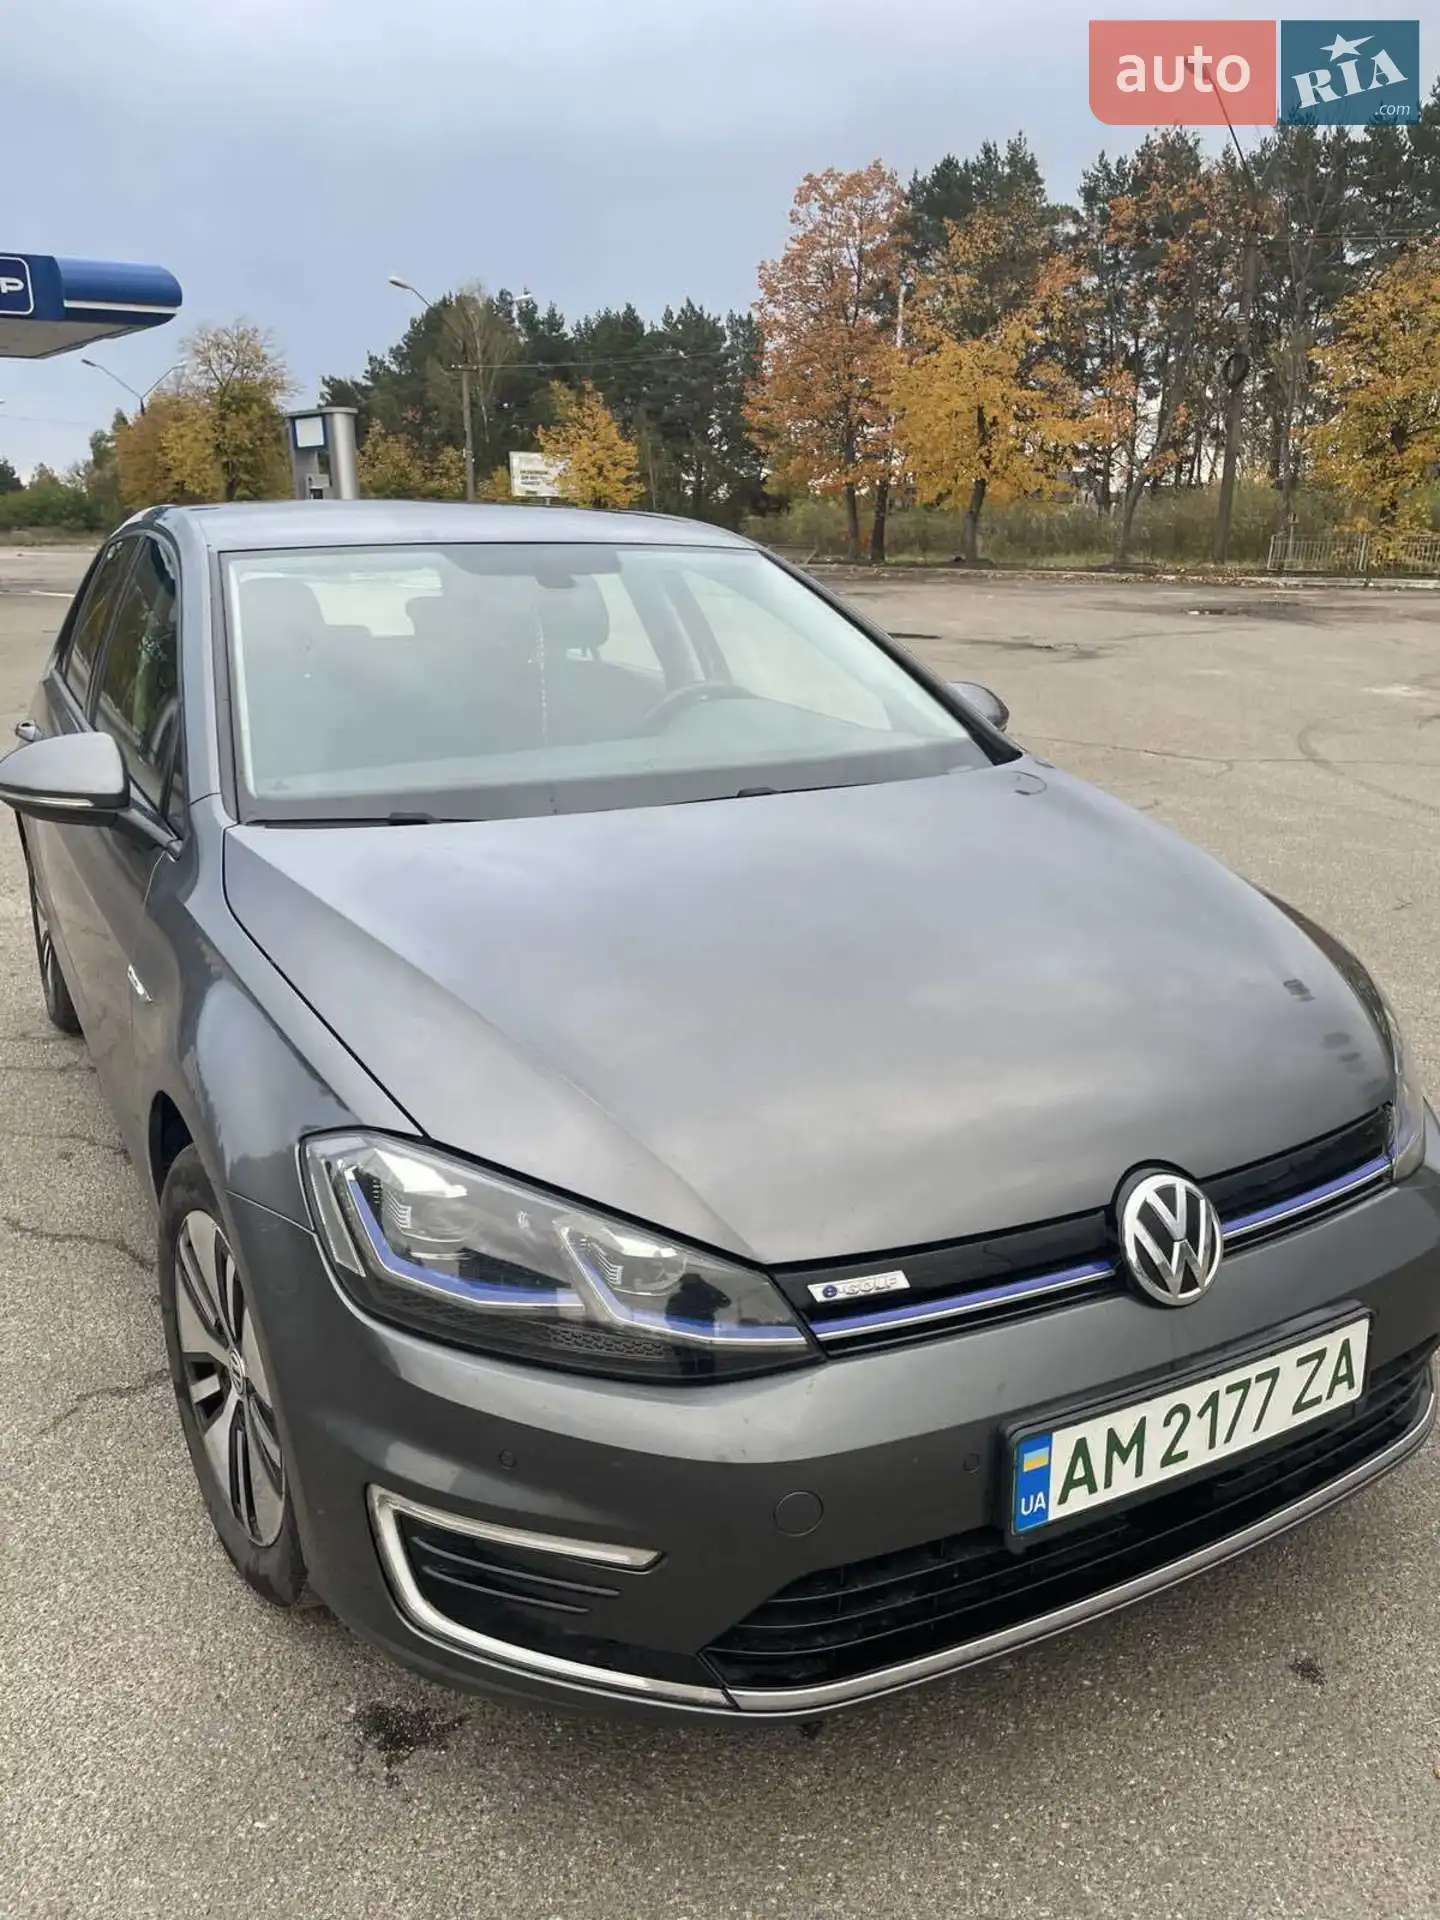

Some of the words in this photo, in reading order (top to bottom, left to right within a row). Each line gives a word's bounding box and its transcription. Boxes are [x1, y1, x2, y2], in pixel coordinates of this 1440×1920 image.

[1057, 1415, 1147, 1505] AM
[1160, 1366, 1280, 1469] 2177
[1292, 1338, 1356, 1416] ZA
[1020, 1491, 1046, 1516] UA
